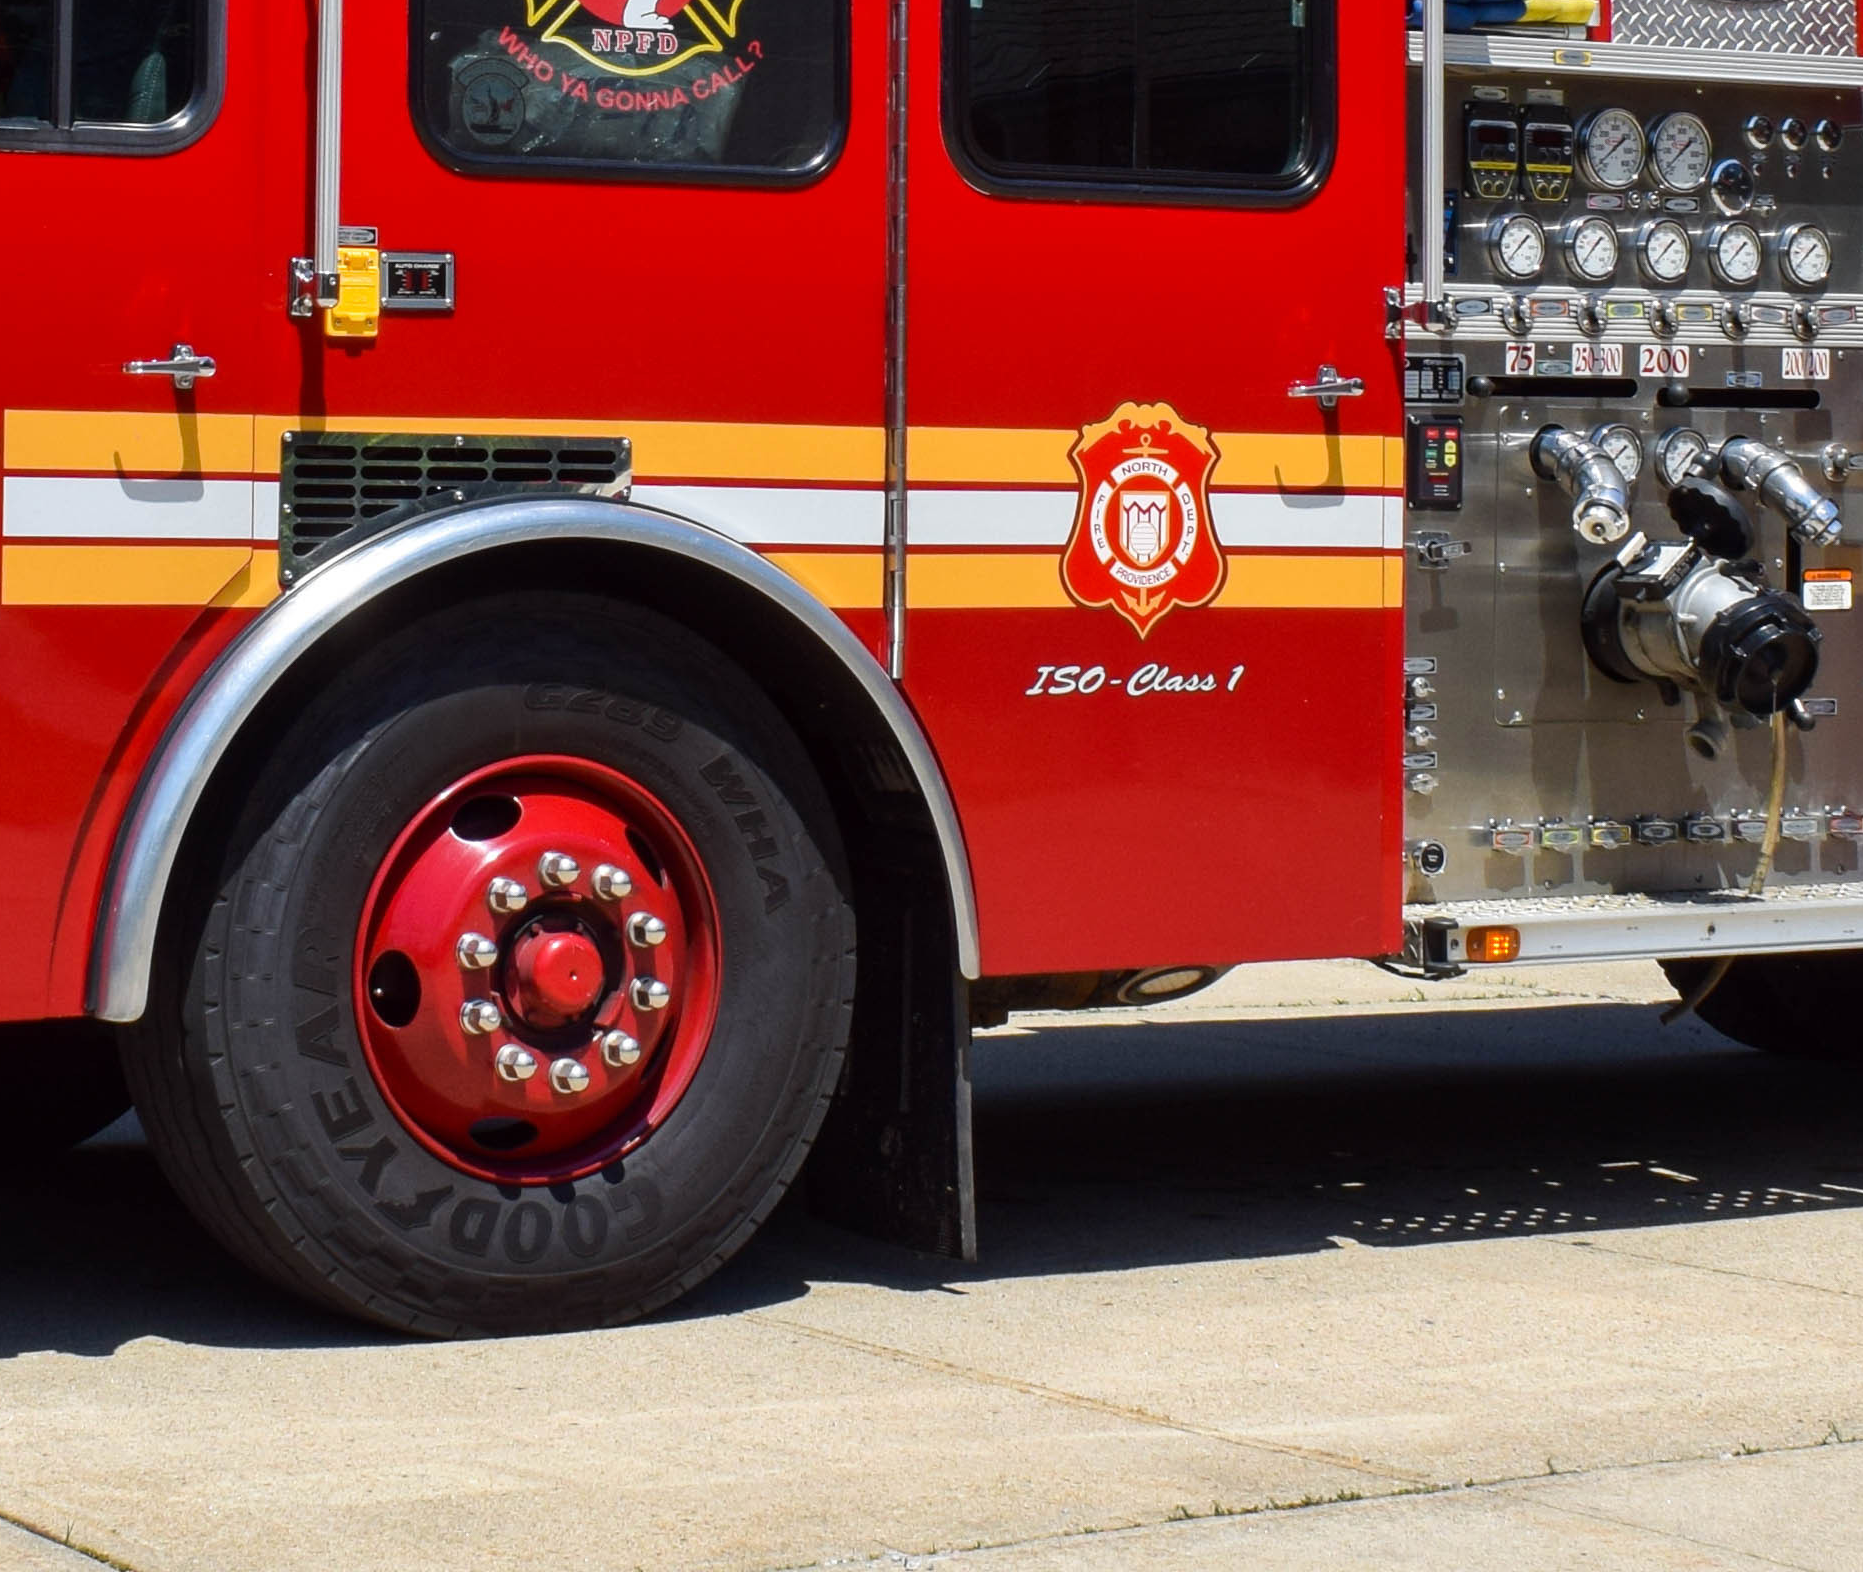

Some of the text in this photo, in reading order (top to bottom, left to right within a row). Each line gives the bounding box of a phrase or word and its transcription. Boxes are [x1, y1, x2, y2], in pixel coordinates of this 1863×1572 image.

[592, 29, 679, 55] NPFD
[498, 26, 554, 83] WHO
[560, 74, 589, 101] YA
[596, 88, 687, 112] GONNA
[1507, 345, 1534, 374] 75
[1574, 346, 1622, 374] 250-300
[1641, 348, 1688, 375] 200
[1121, 461, 1169, 477] NORTH
[1093, 494, 1106, 549] FIRE
[1115, 566, 1172, 586] PROVIDENCE
[1226, 665, 1245, 692] 1
